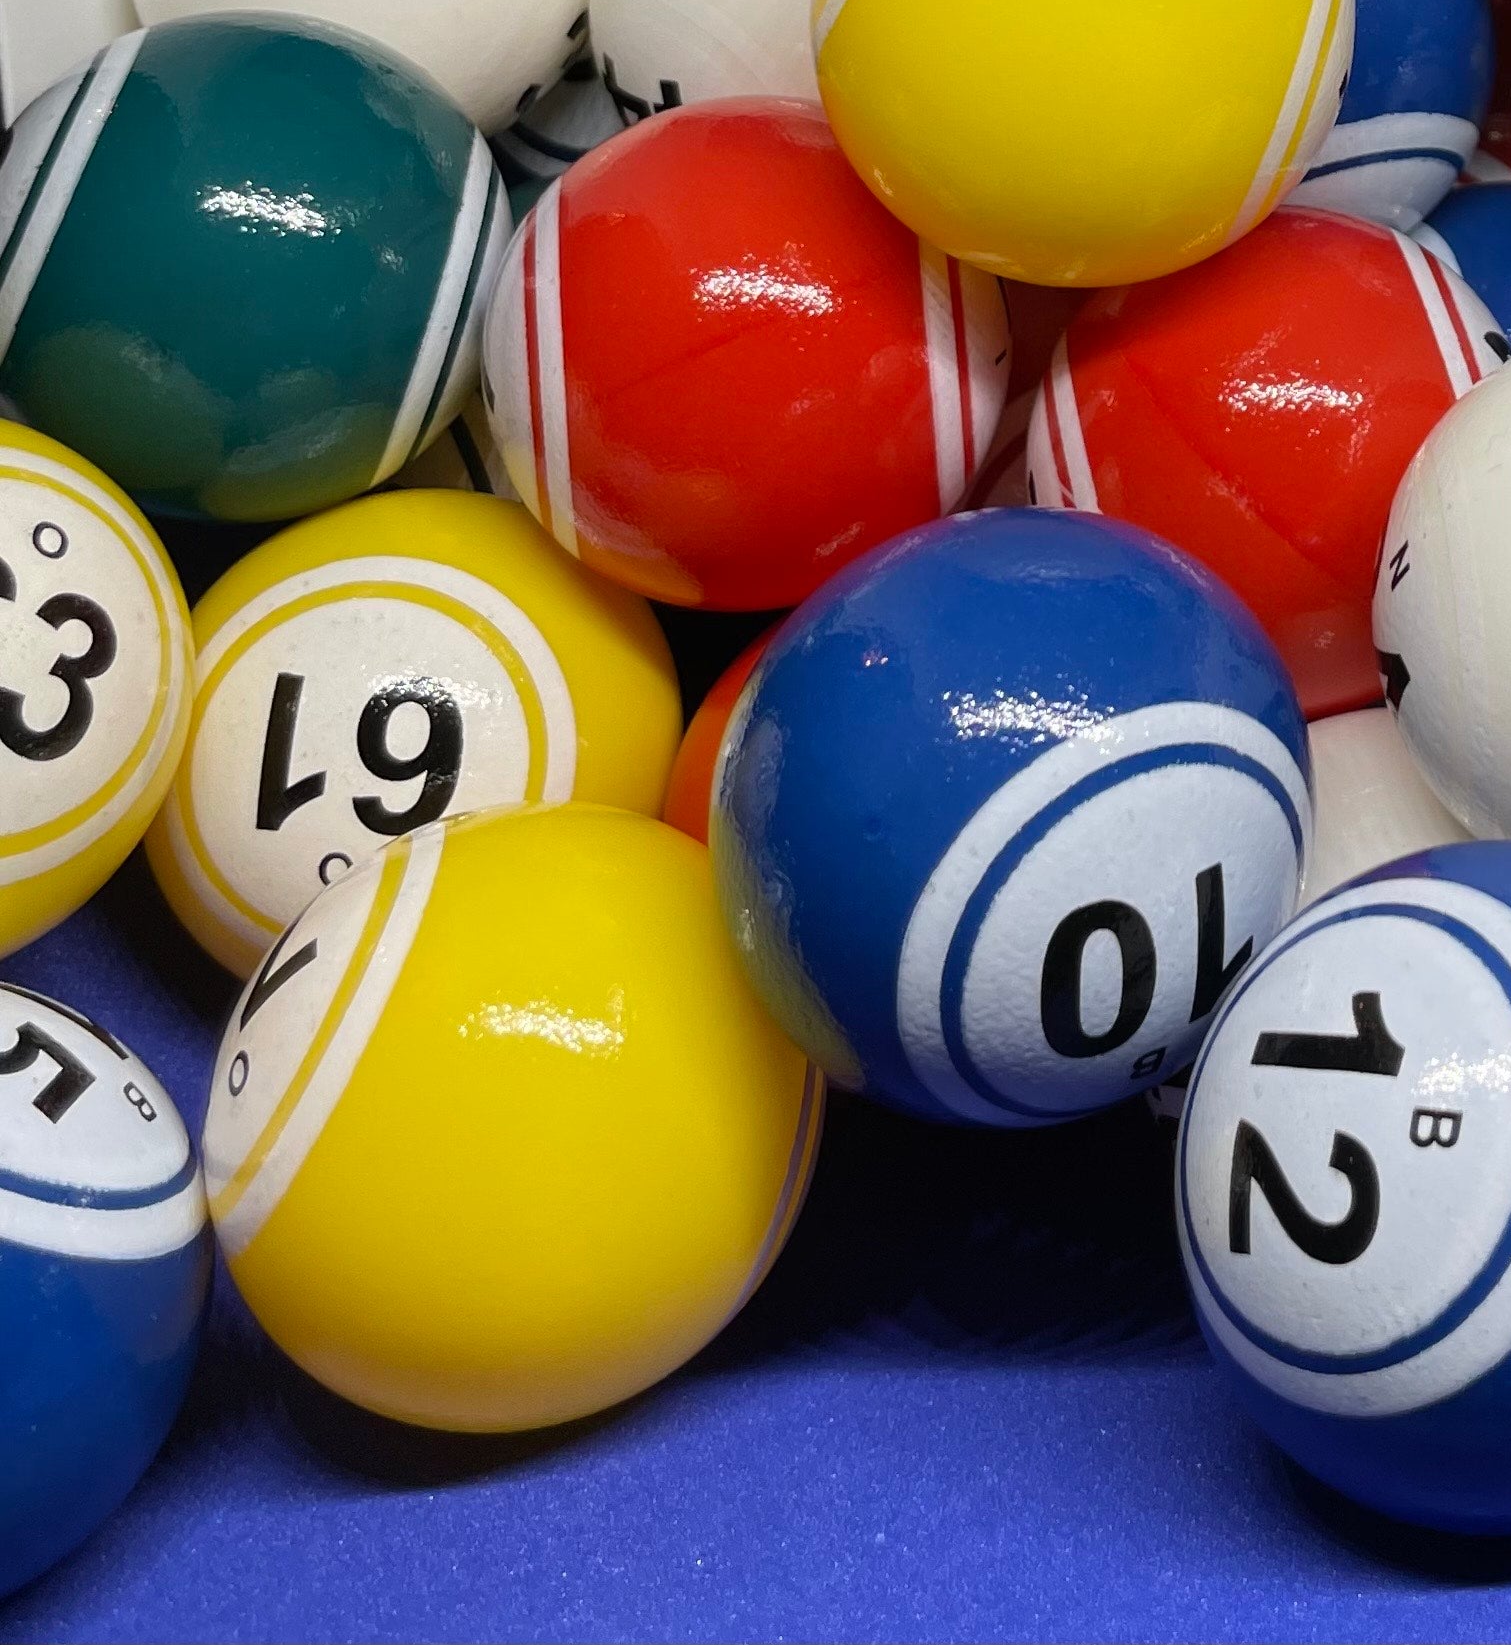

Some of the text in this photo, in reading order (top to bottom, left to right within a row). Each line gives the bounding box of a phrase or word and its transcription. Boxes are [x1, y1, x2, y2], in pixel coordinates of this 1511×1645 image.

[32, 520, 69, 559] O
[1389, 539, 1410, 592] N
[256, 672, 464, 836] 61
[1040, 863, 1255, 1058] 10
[228, 1050, 250, 1097] O
[1129, 1046, 1167, 1080] B
[123, 1081, 157, 1122] B
[1229, 992, 1405, 1265] 12
[1410, 1107, 1463, 1149] B
